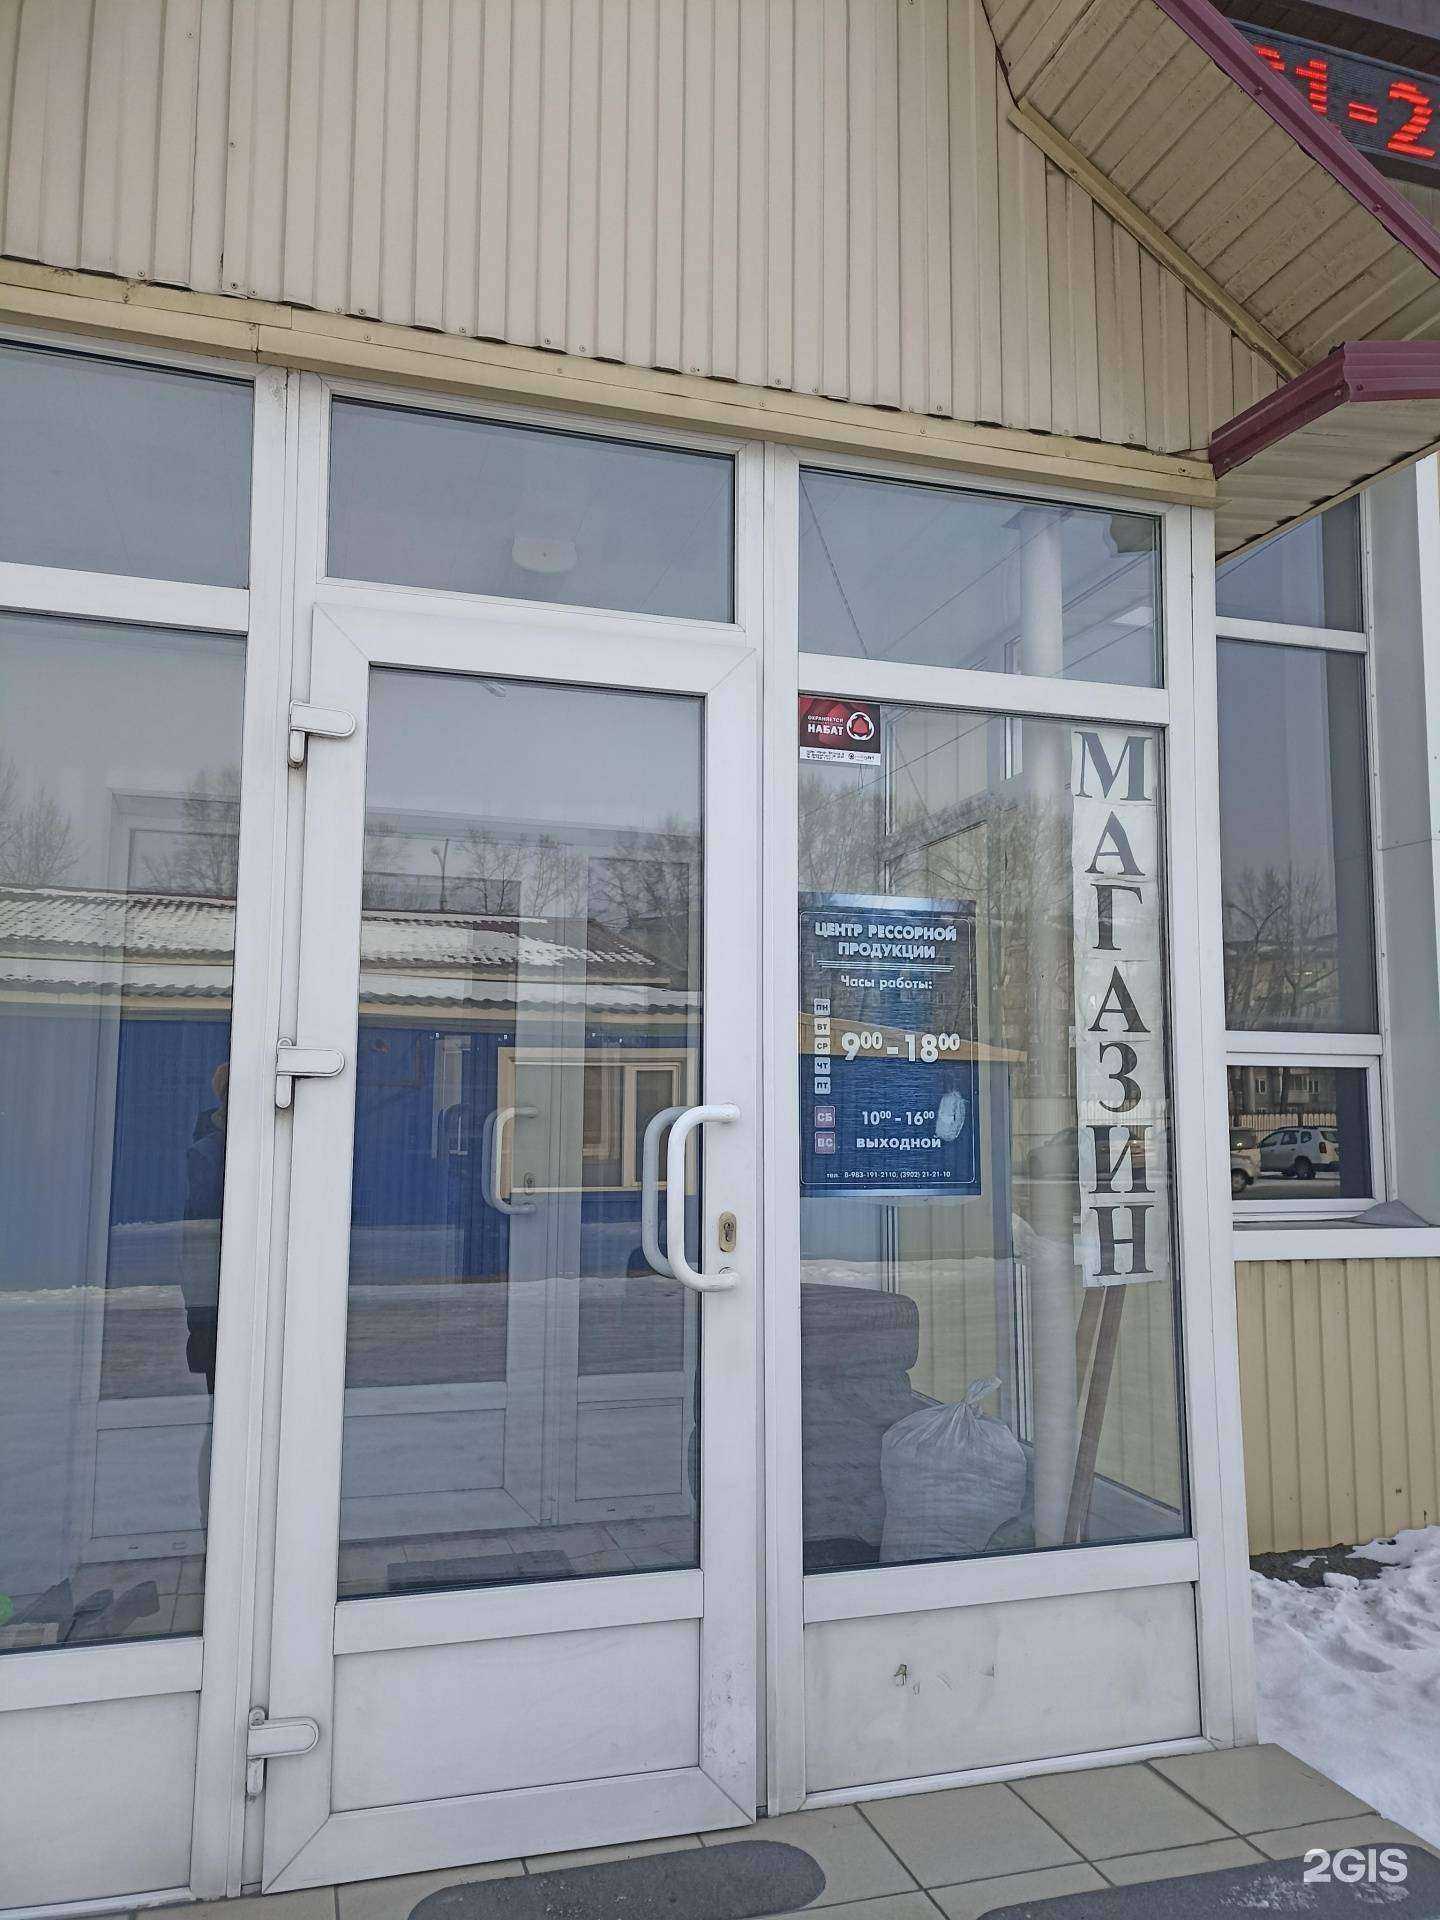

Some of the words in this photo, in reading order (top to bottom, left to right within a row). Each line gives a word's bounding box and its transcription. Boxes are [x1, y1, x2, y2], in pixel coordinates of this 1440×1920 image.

[808, 723, 844, 736] НАБАТ
[815, 921, 863, 938] ЦЕНТР
[868, 923, 957, 942] РЕССОРНОЙ
[838, 942, 936, 960] ПРОДУКЦИИ
[841, 975, 875, 988] Часы
[879, 976, 933, 991] работы:
[1074, 731, 1155, 1277] МАГАЗИН
[816, 1112, 833, 1121] СБ
[817, 1137, 834, 1147] ВС
[922, 1170, 951, 1178] 21-21-10
